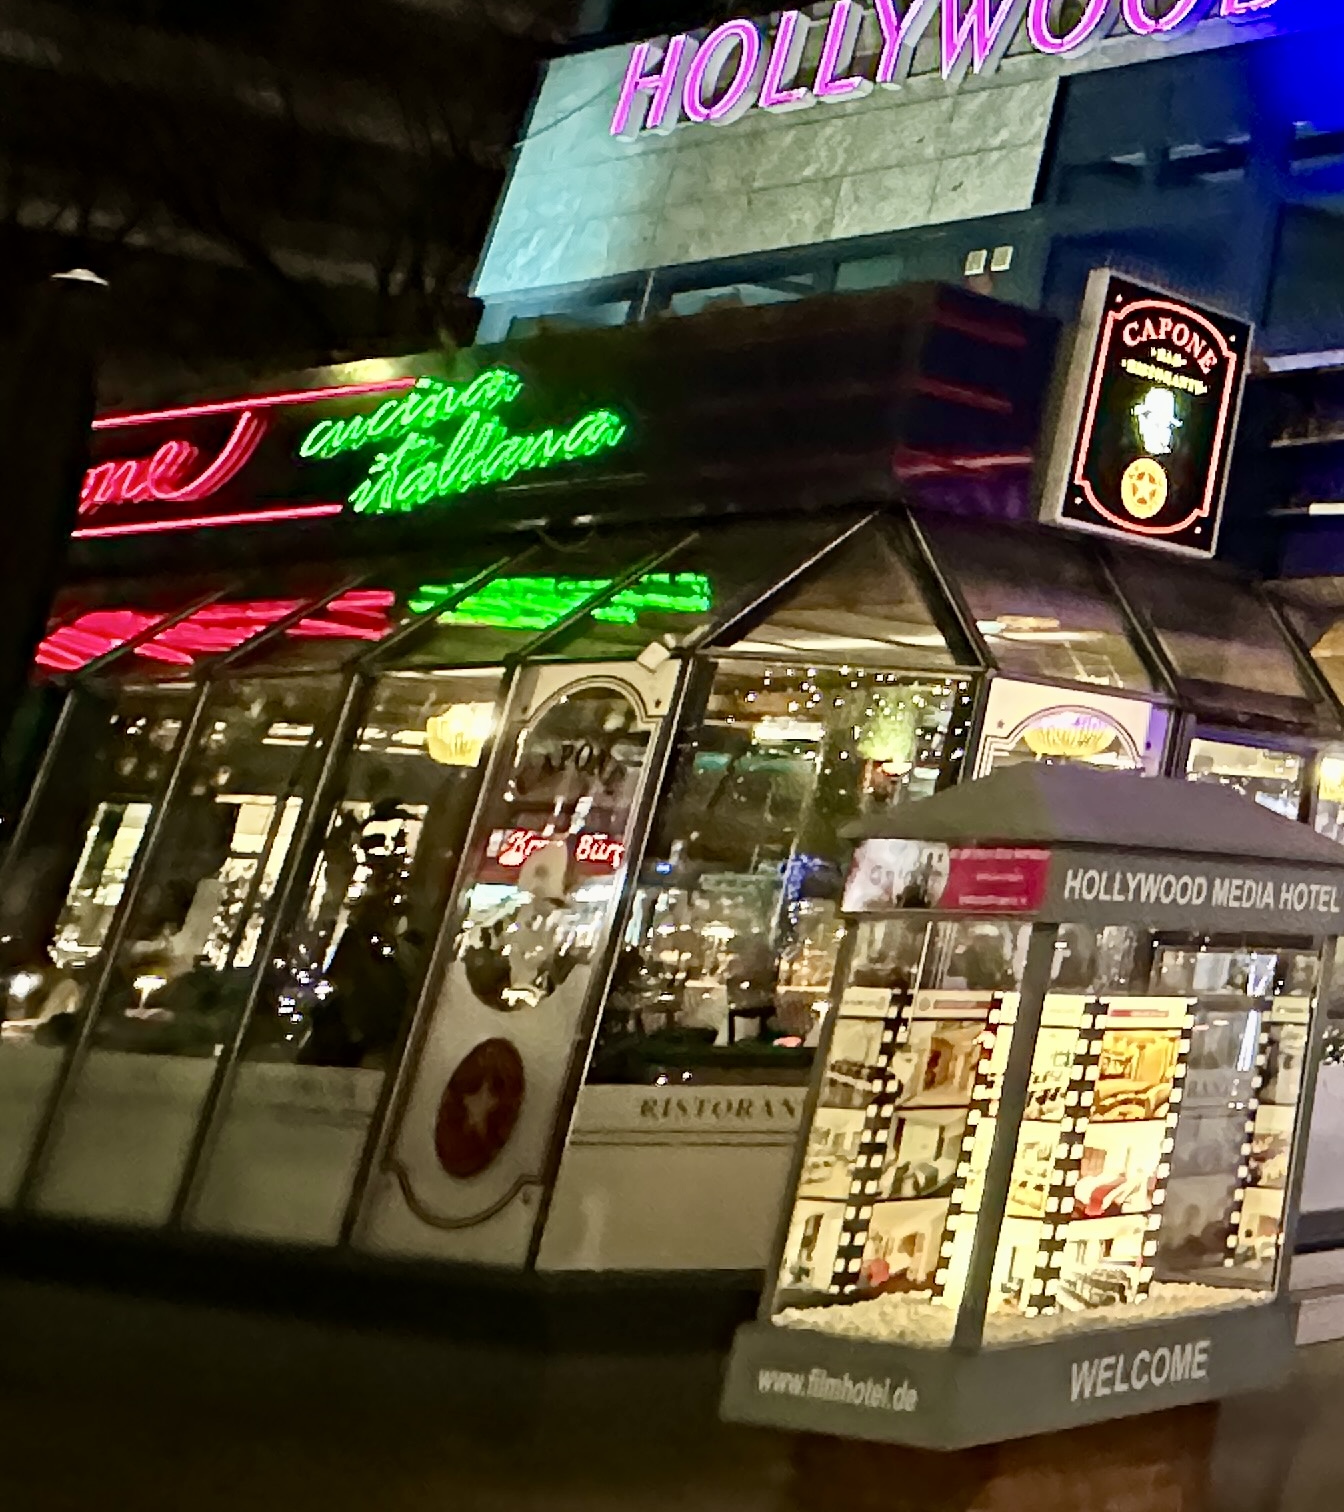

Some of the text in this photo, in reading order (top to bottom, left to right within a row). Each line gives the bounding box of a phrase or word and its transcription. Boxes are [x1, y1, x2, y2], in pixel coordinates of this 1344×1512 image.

[1123, 317, 1217, 375] CAPONE
[1064, 868, 1340, 913] HOLLYWOOD MEDIA HOTEL
[640, 1095, 796, 1120] RISTORAN
[758, 1368, 918, 1412] www.filmhotel.de
[1070, 1339, 1211, 1402] WELCOME
